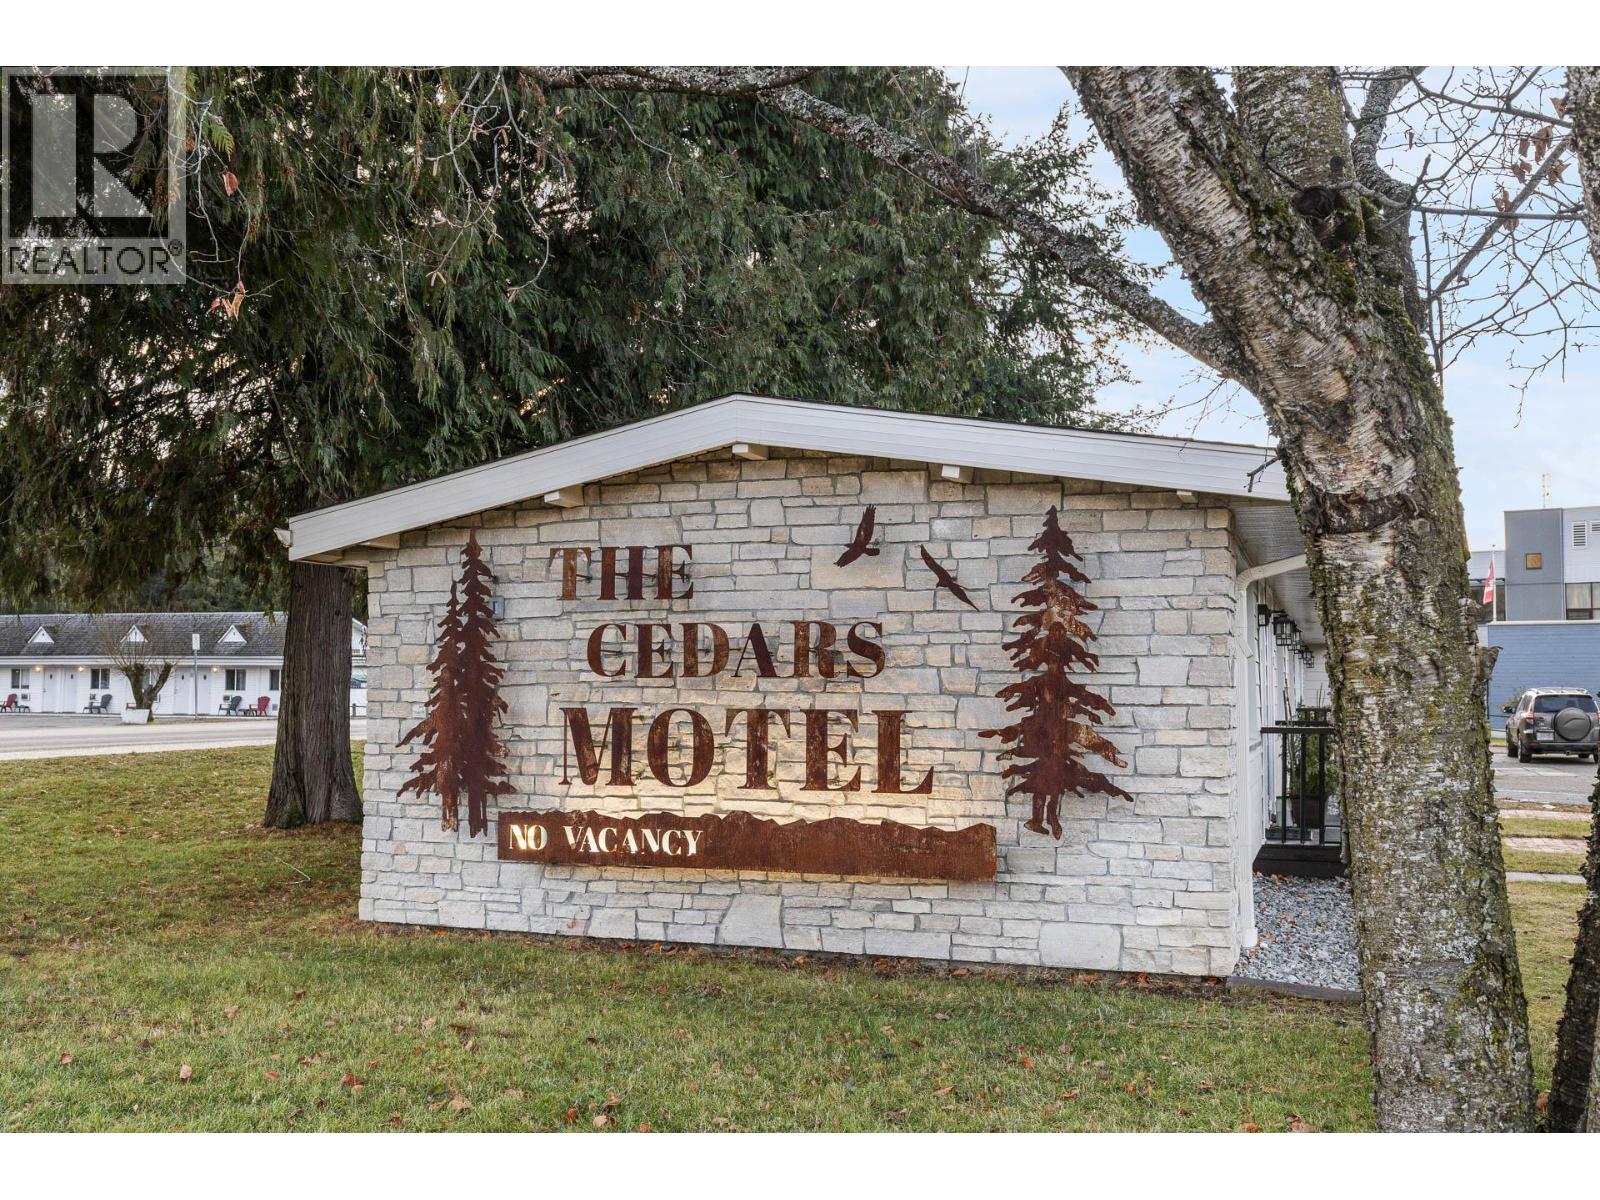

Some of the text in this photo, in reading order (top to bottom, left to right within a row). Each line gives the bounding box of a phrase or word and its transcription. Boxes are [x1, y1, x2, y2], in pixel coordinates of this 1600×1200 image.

[550, 545, 693, 600] THE
[587, 622, 885, 678] CEDARS
[559, 707, 934, 794] MOTEL
[509, 824, 703, 856] NO VACANCY
